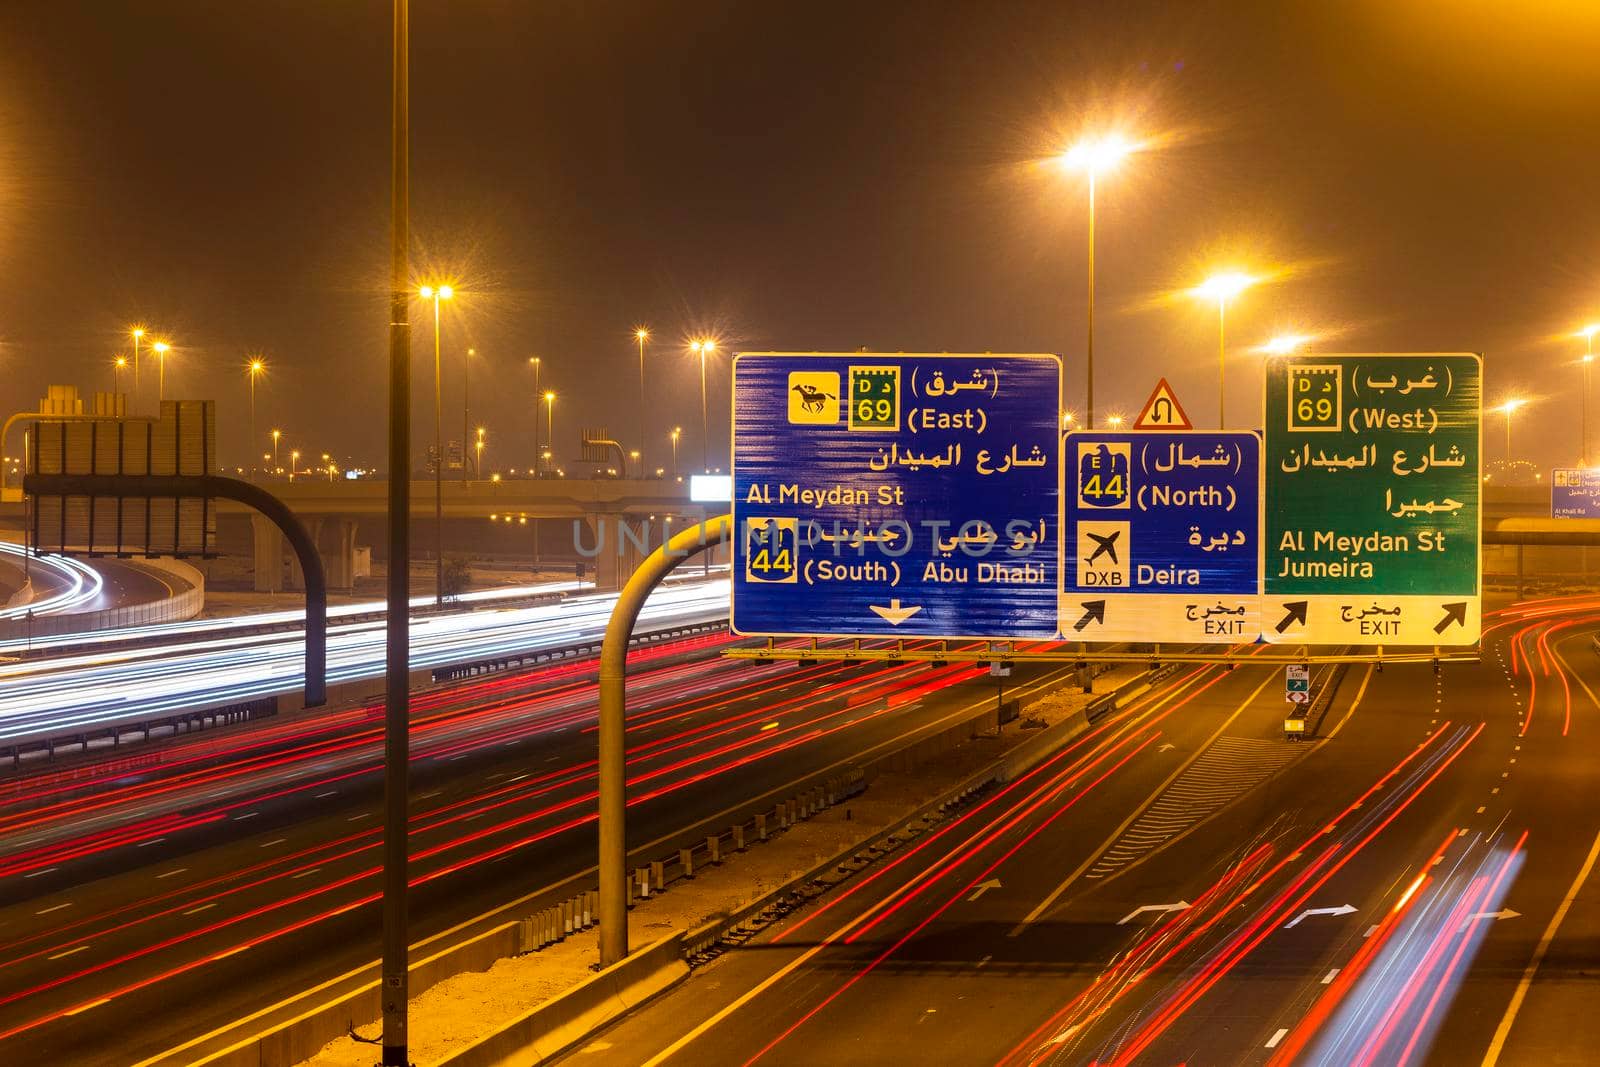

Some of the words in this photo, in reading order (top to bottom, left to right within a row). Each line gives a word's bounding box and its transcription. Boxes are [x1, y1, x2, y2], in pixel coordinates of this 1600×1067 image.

[859, 379, 871, 393] D
[911, 366, 999, 399] (شرق)
[1299, 378, 1311, 392] D
[1352, 365, 1453, 398] (غرب)
[858, 399, 891, 422] 69
[907, 408, 987, 434] (East)
[1297, 398, 1332, 421] 69
[1349, 407, 1438, 434] (West)
[869, 443, 961, 471] الميدان
[976, 444, 1047, 475] شارع
[1092, 456, 1101, 469] E
[1141, 442, 1242, 476] (شمال)
[1281, 443, 1376, 473] الميدان
[1392, 444, 1466, 476] شارع
[747, 484, 771, 504] Al
[780, 484, 868, 508] Meydan
[878, 485, 904, 505] St
[1083, 474, 1125, 499] 44
[1137, 484, 1237, 512] (North)
[1386, 488, 1464, 518] جميرا
[1188, 526, 1246, 552] ديرة
[1279, 531, 1305, 551] Al
[1314, 531, 1409, 556] Meydan
[1417, 531, 1446, 552] St
[752, 549, 792, 573] 44
[804, 559, 901, 586] (South)
[922, 562, 968, 583] Abu
[977, 562, 1046, 584] Dhabi
[1279, 557, 1373, 578] Jumeira
[1085, 571, 1123, 586] DXB
[1137, 564, 1200, 585] Deira
[1186, 601, 1246, 621] مخرج
[1340, 601, 1402, 621] مخرج
[1204, 620, 1246, 635] EXIT
[1360, 620, 1402, 635] EXIT
